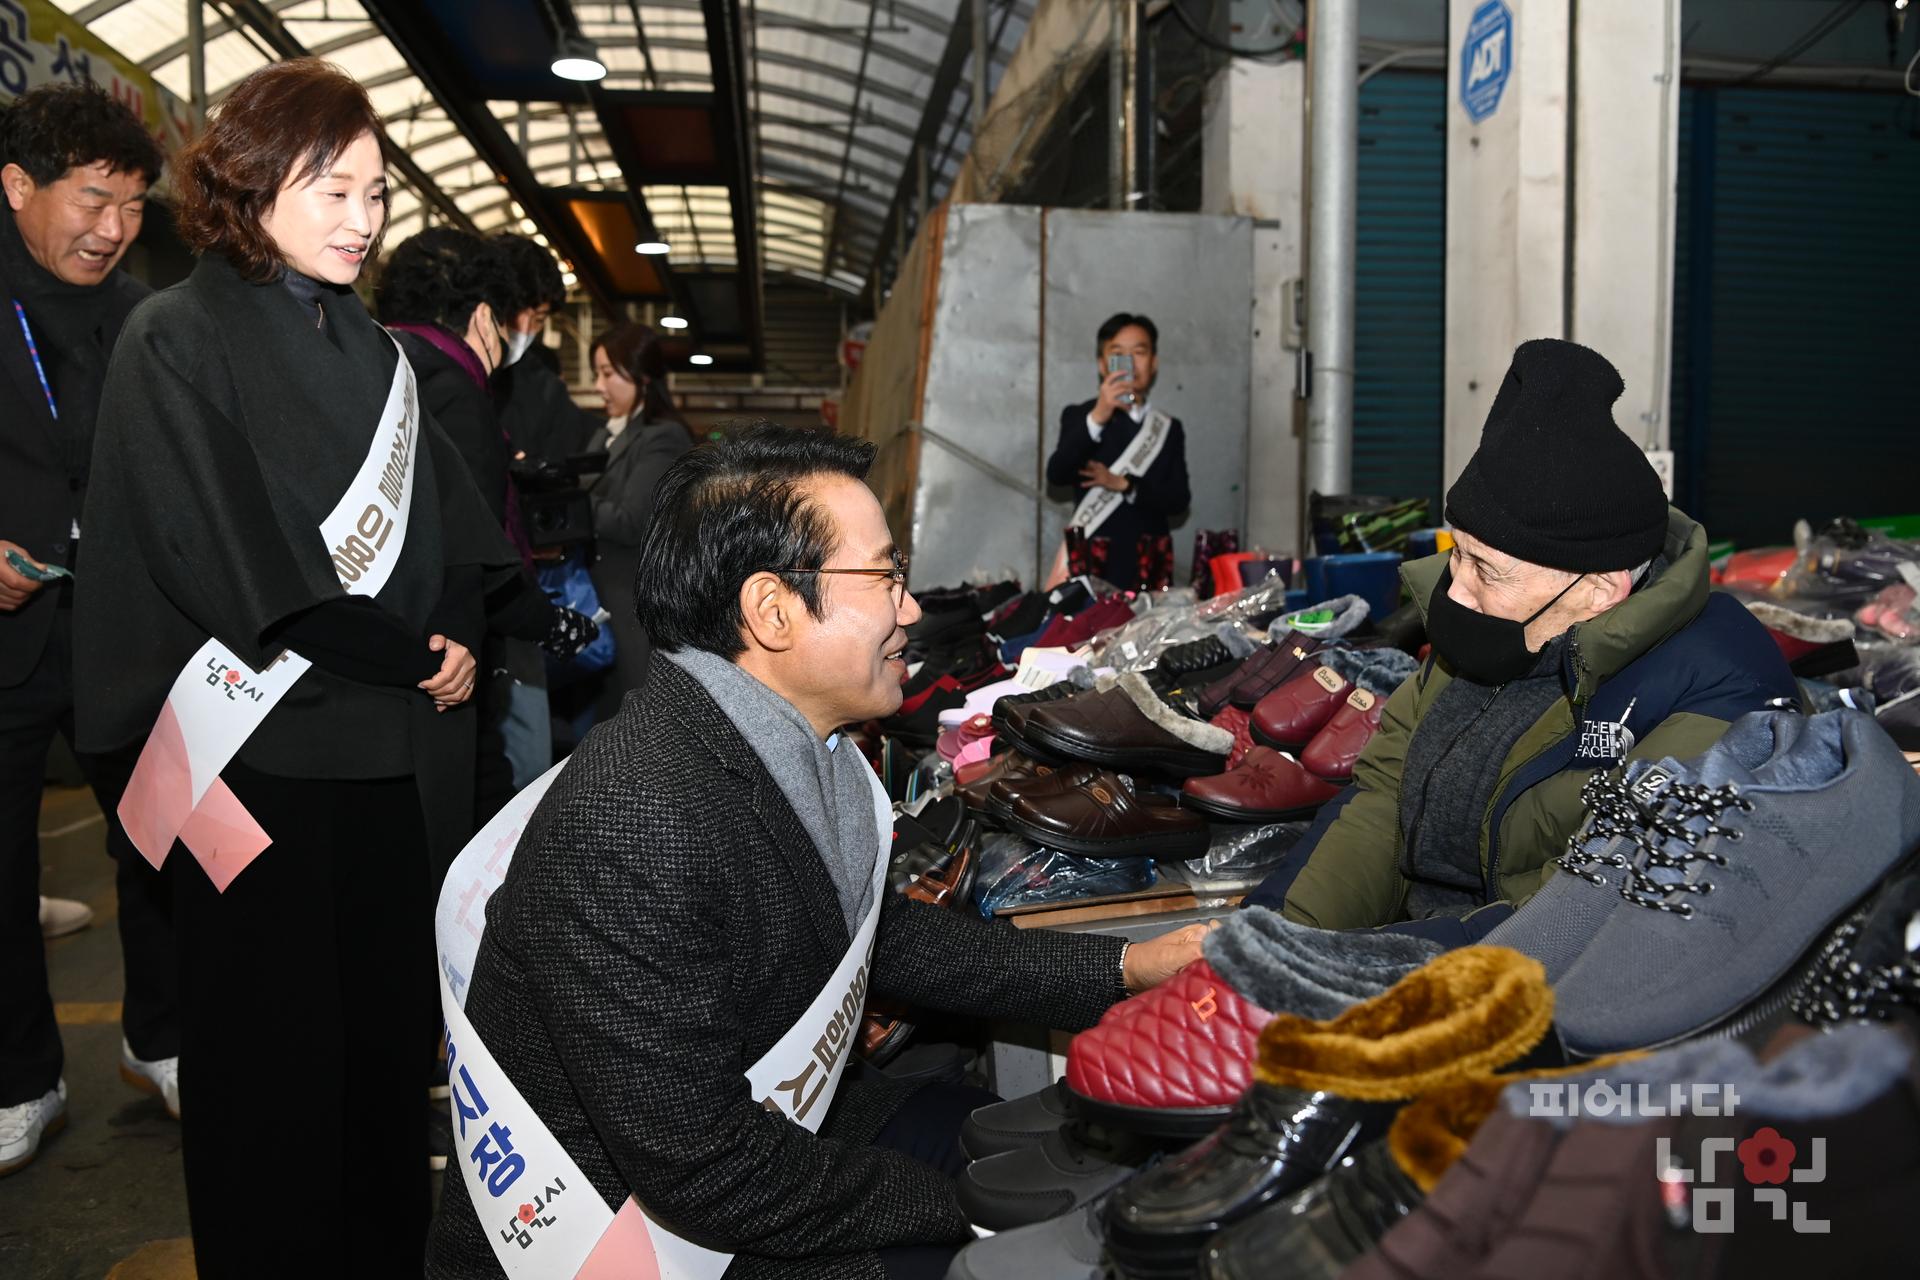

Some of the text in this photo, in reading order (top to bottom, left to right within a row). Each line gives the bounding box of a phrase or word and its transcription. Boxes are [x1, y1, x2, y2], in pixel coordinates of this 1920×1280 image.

[1467, 28, 1505, 89] ADT
[331, 503, 394, 590] 이용
[1582, 733, 1610, 746] RTH
[1584, 720, 1609, 734] THE
[1576, 744, 1610, 758] FACE
[762, 932, 877, 1121] 용합시
